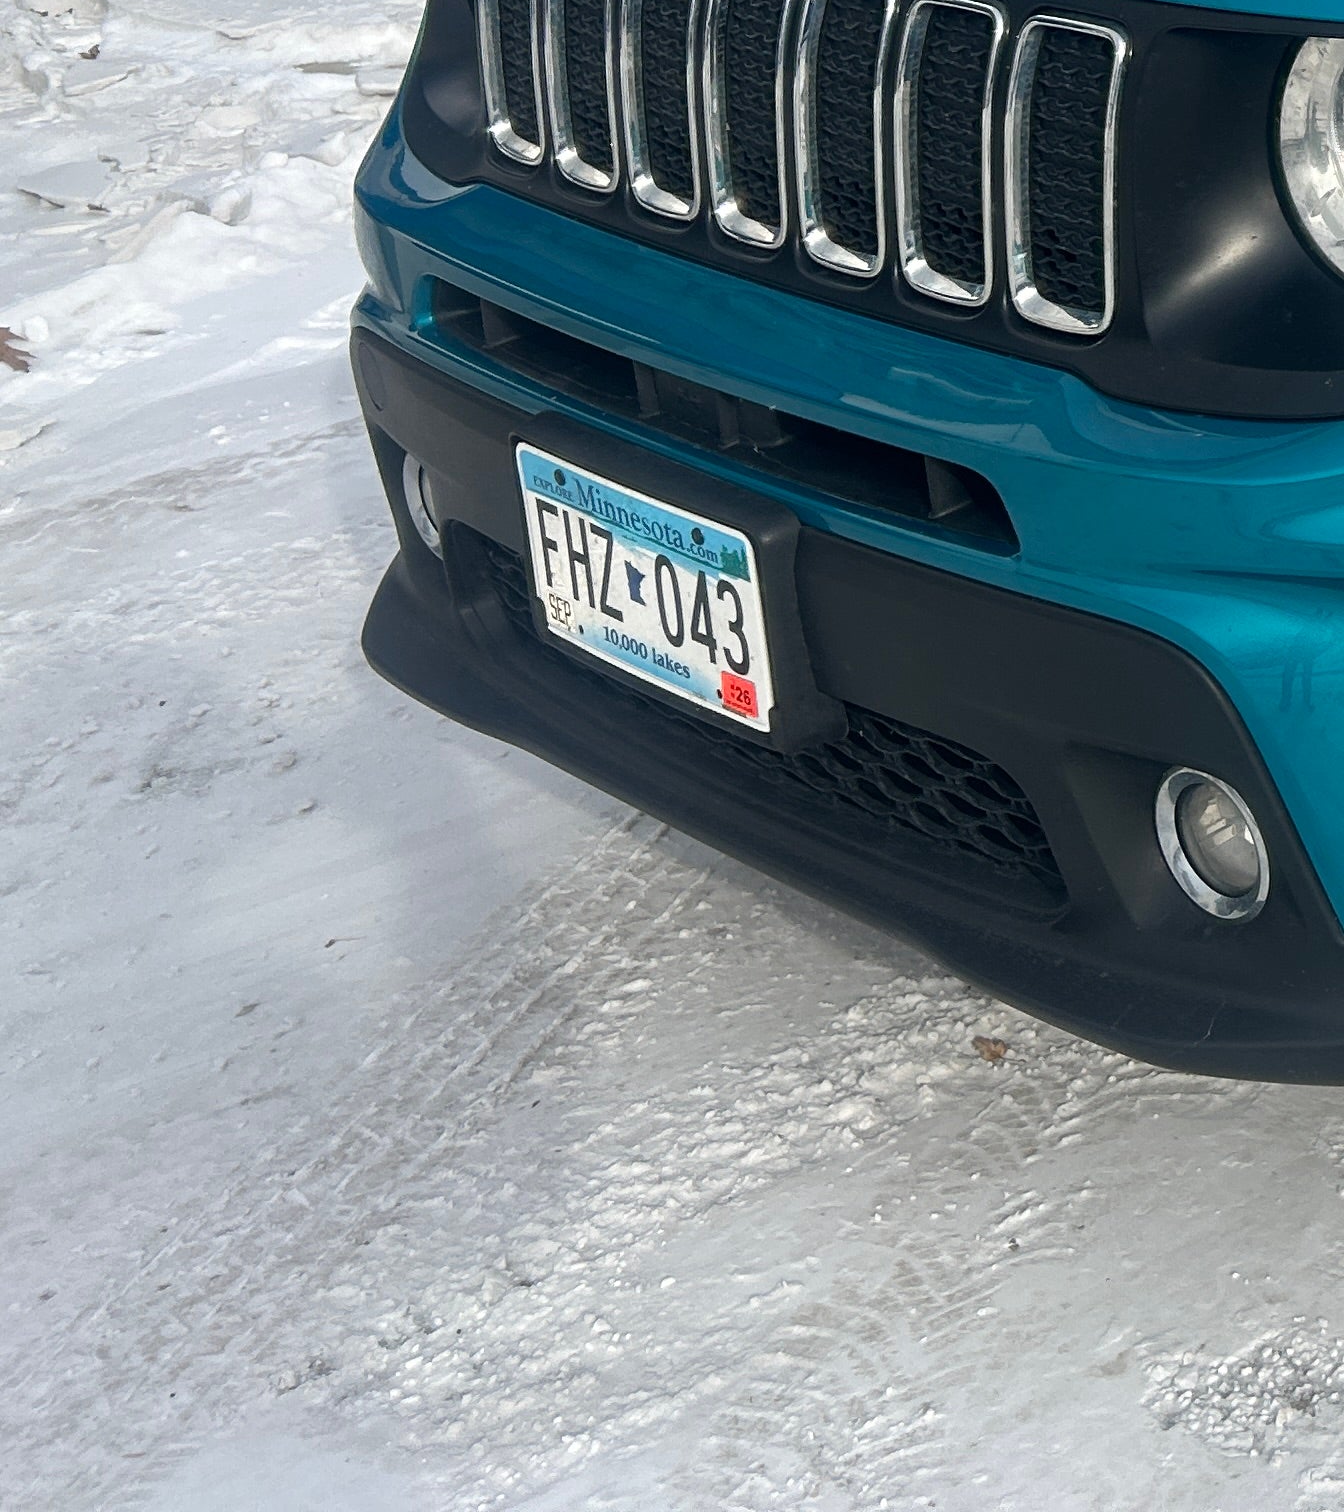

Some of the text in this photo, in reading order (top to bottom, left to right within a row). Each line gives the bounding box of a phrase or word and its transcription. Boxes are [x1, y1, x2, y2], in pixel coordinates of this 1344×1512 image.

[533, 475, 718, 564] EXPLORE Minnesota.com
[535, 497, 750, 676] FHZ 043
[549, 592, 573, 626] SEP
[602, 624, 691, 679] 10,000 lakes
